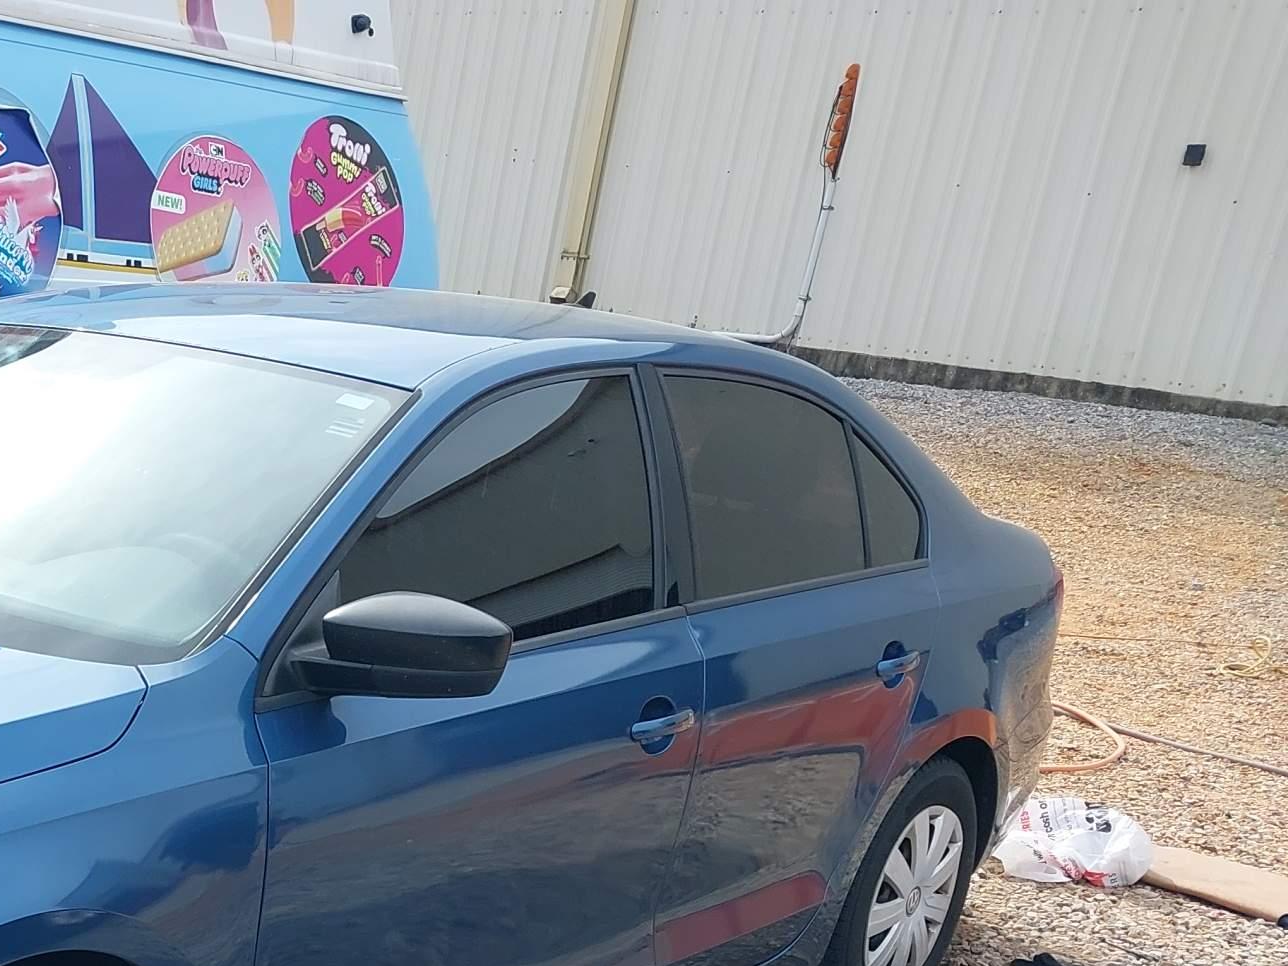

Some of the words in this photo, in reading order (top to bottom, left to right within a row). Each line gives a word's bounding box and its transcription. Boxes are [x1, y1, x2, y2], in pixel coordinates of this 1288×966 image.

[329, 123, 371, 166] Trolli
[181, 146, 250, 186] POWERPUFF
[158, 194, 183, 210] NEW!
